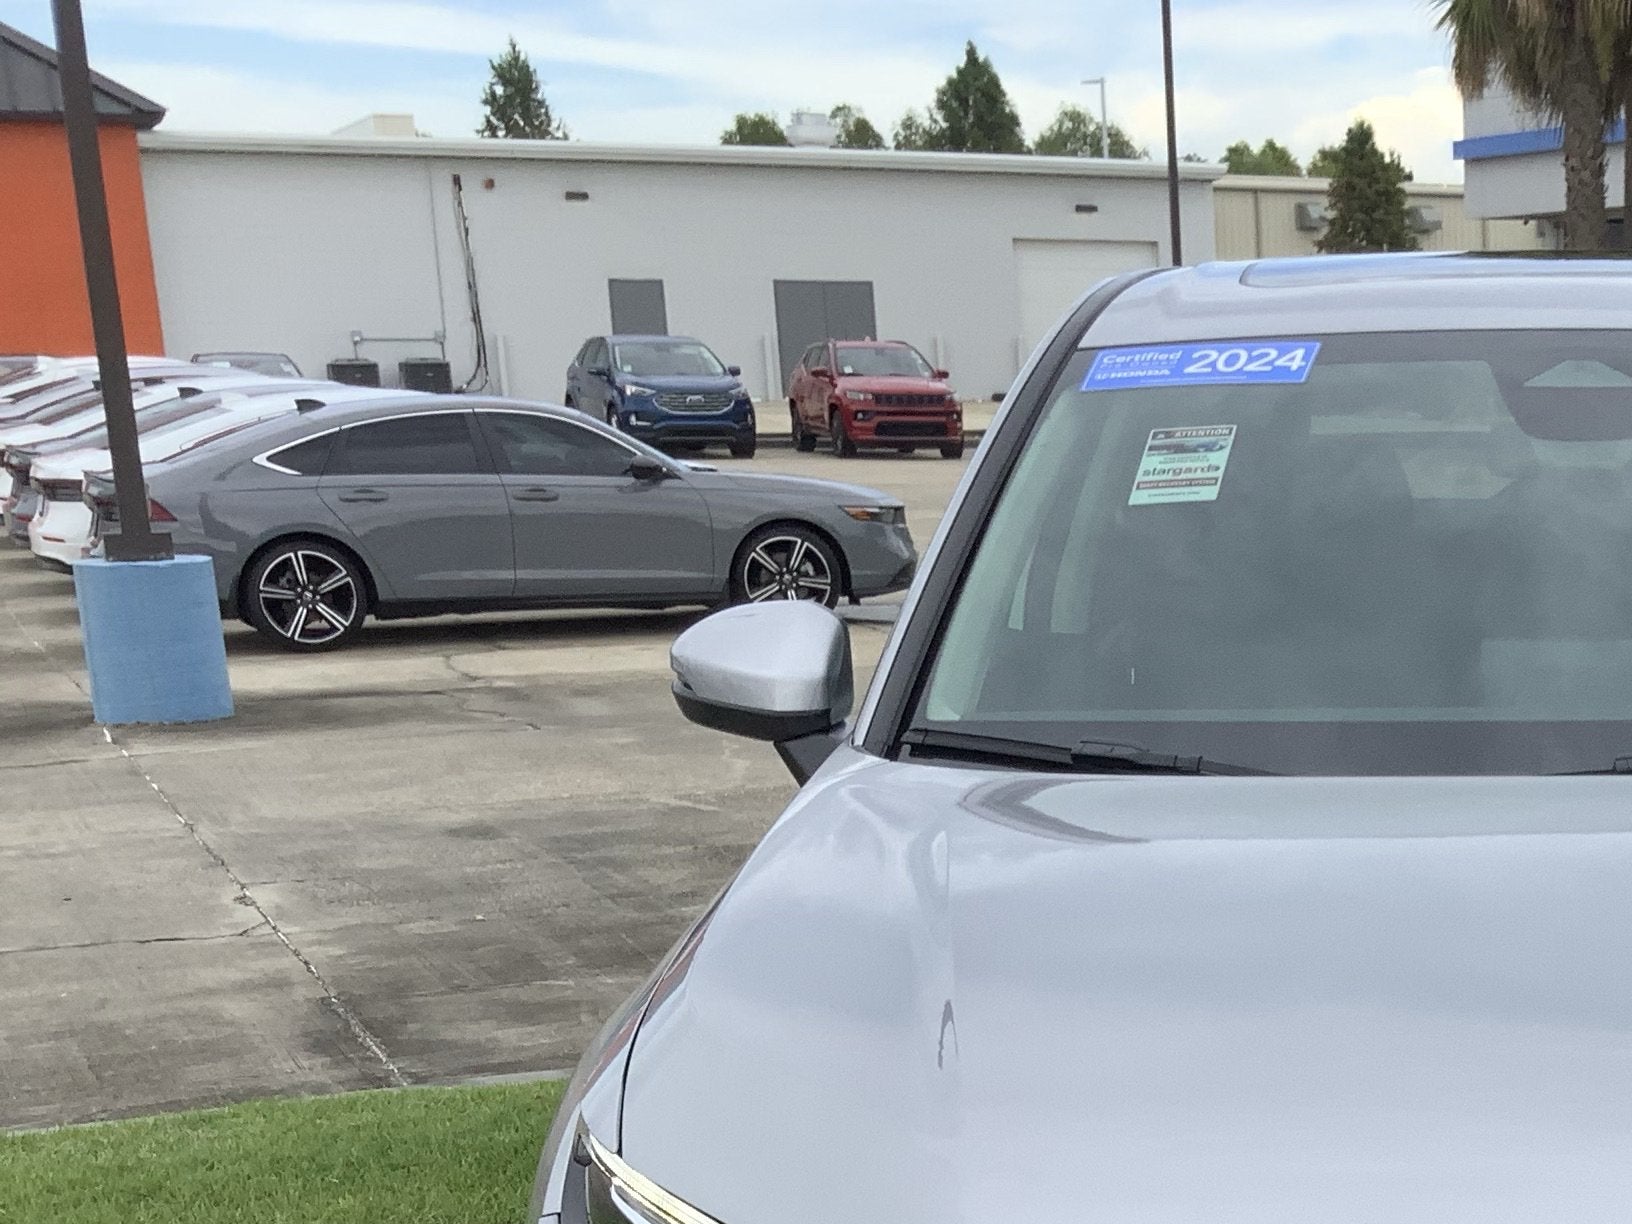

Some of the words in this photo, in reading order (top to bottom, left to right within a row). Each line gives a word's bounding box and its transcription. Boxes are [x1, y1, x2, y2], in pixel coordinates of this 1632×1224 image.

[1103, 350, 1182, 364] Certified
[1183, 348, 1307, 374] 2024
[1174, 428, 1230, 438] ATTENTION
